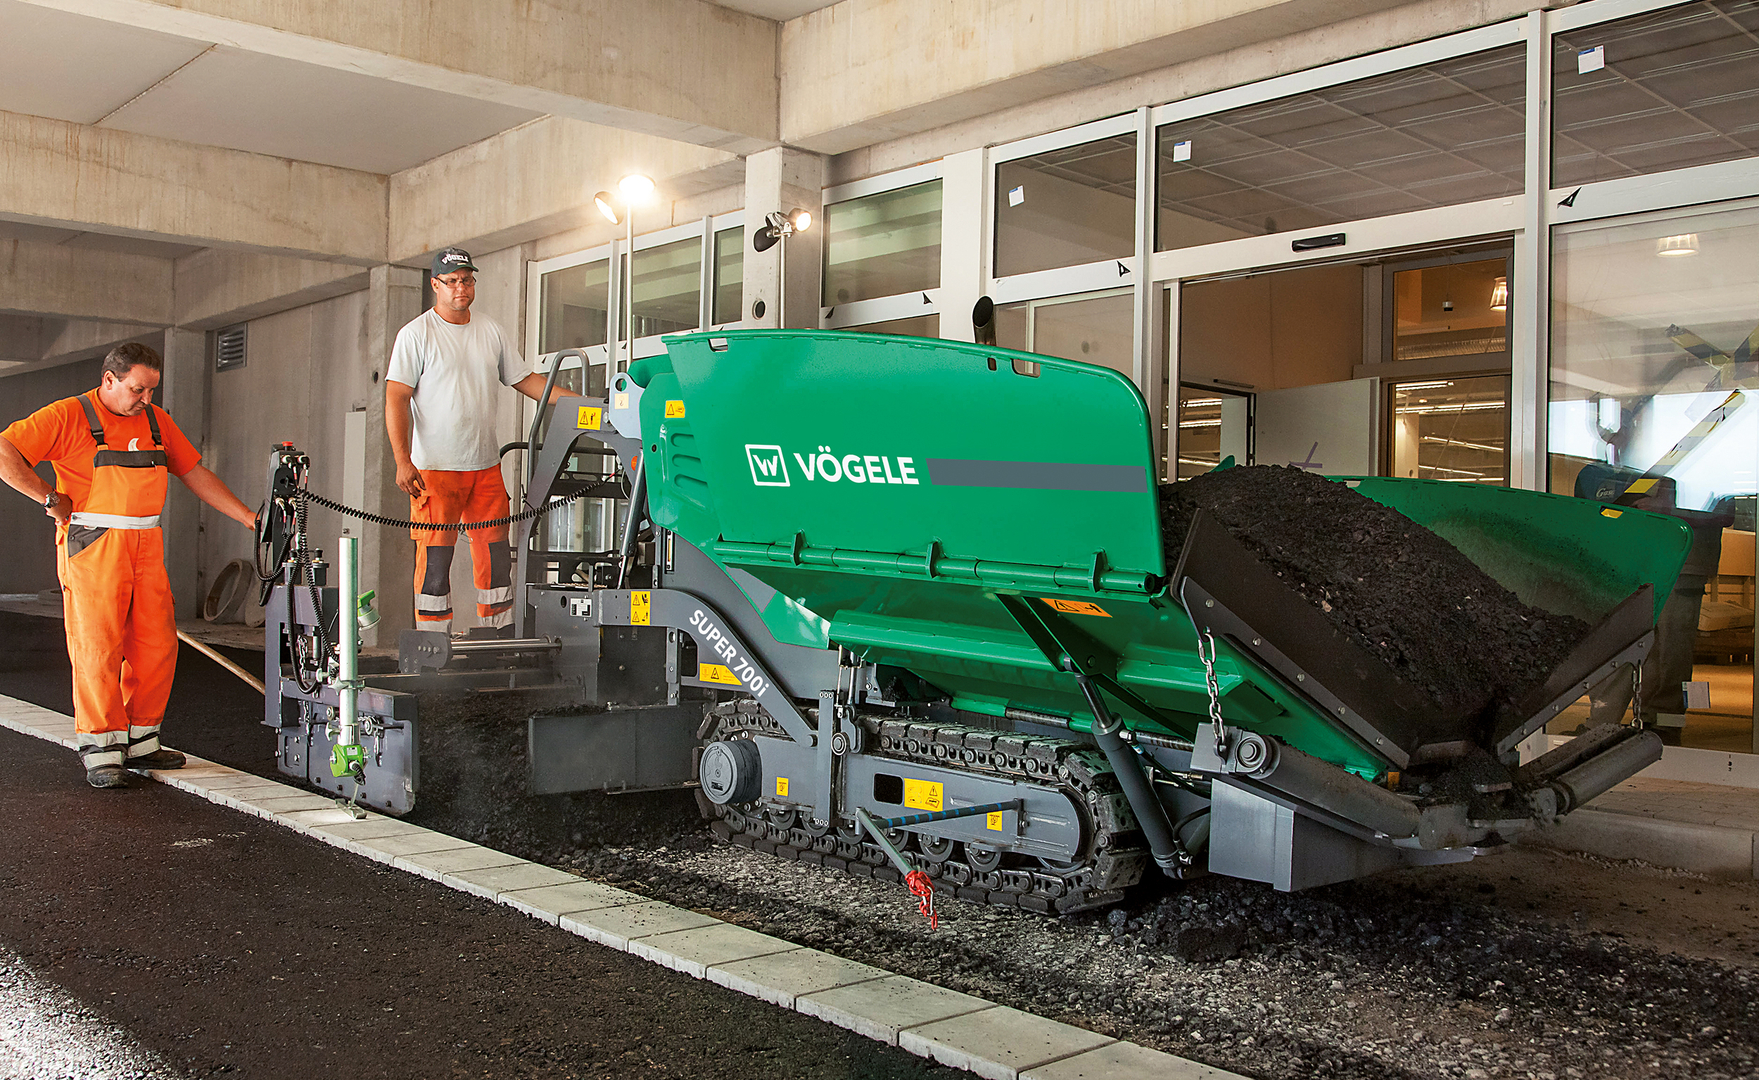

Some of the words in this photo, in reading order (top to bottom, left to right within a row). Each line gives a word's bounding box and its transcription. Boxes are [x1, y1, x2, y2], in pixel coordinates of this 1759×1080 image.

[793, 445, 920, 485] VÖGELE
[689, 609, 737, 664] SUPER
[733, 656, 770, 697] 700i
